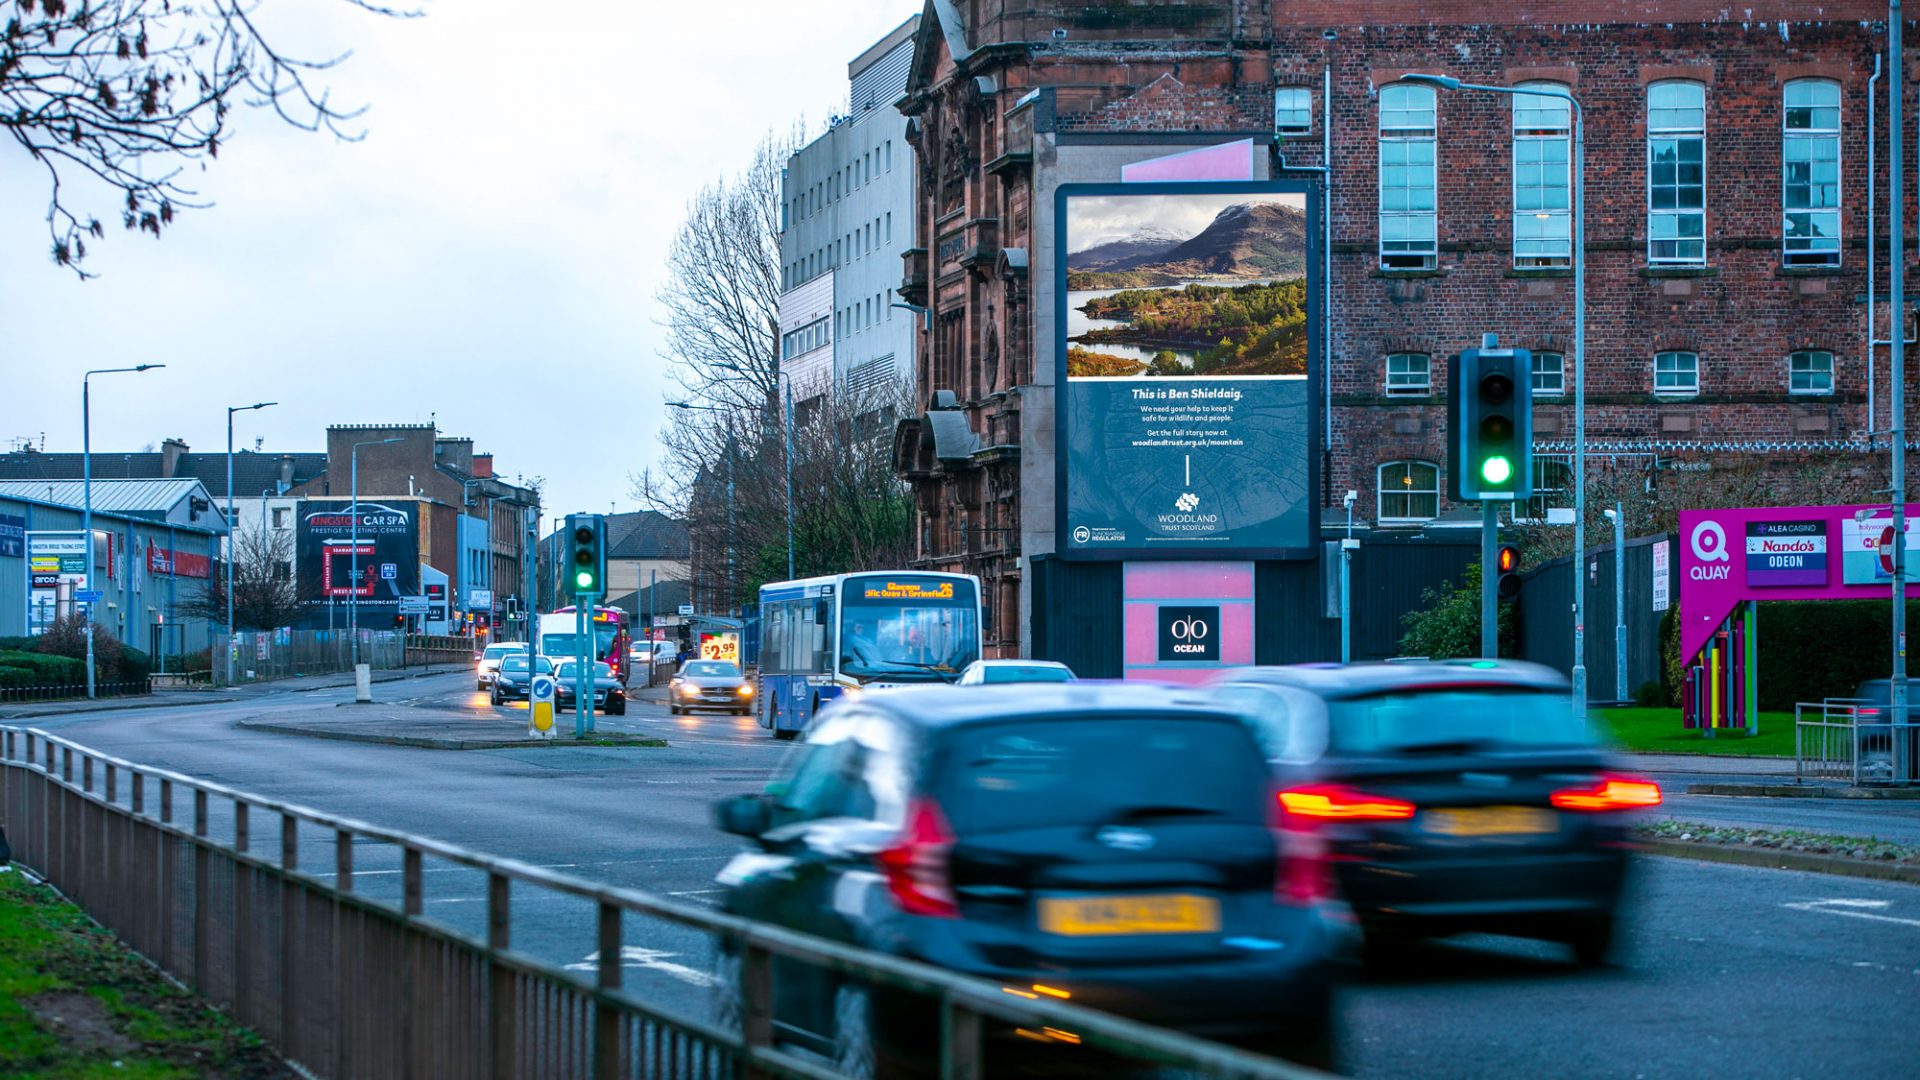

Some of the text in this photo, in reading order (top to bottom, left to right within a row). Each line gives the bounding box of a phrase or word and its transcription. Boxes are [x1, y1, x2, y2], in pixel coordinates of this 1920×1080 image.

[1132, 388, 1243, 401] This is Ben Shieldaig.
[1187, 405, 1201, 414] help
[1211, 405, 1227, 414] keep
[1209, 415, 1232, 423] people.
[1132, 439, 1244, 448] woodlandtrust.org.uk/mountain
[310, 516, 406, 526] KINGSTON CAR SPA
[1158, 514, 1217, 523] WOODLAND
[1788, 524, 1816, 532] CASINO
[1762, 540, 1814, 552] Nando's
[1769, 555, 1803, 567] ODEON
[1690, 566, 1730, 580] QUAY
[940, 583, 953, 598] 26
[1174, 645, 1205, 653] OCEAN
